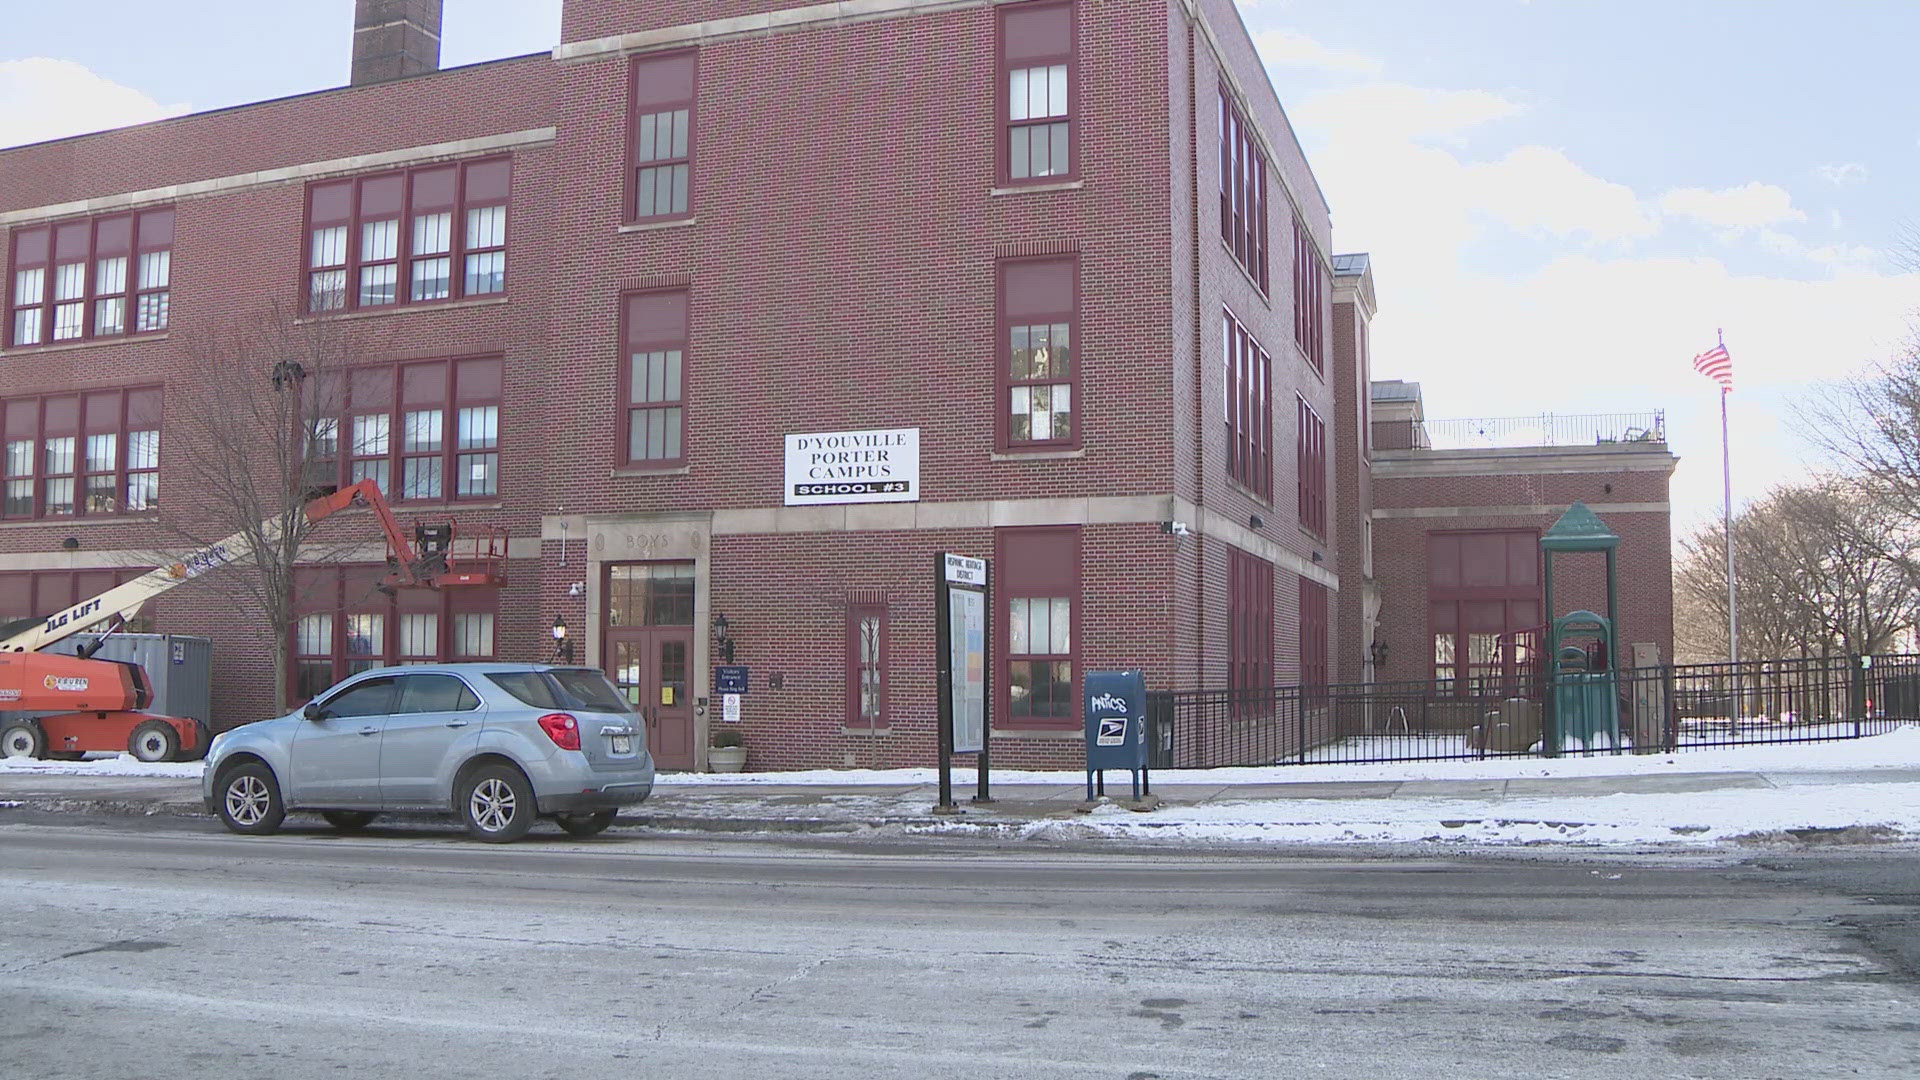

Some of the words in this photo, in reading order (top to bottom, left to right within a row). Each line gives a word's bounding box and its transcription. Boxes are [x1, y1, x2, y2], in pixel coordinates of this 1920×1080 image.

[797, 433, 907, 450] D'YOUVILLE
[811, 450, 889, 465] PORTER
[809, 465, 891, 479] CAMPUS
[799, 484, 877, 494] SCHOOL
[883, 482, 905, 493] #3
[626, 534, 669, 549] BOYS
[956, 569, 974, 580] DISTRICT
[44, 613, 68, 633] JLG
[73, 598, 101, 621] LIFT
